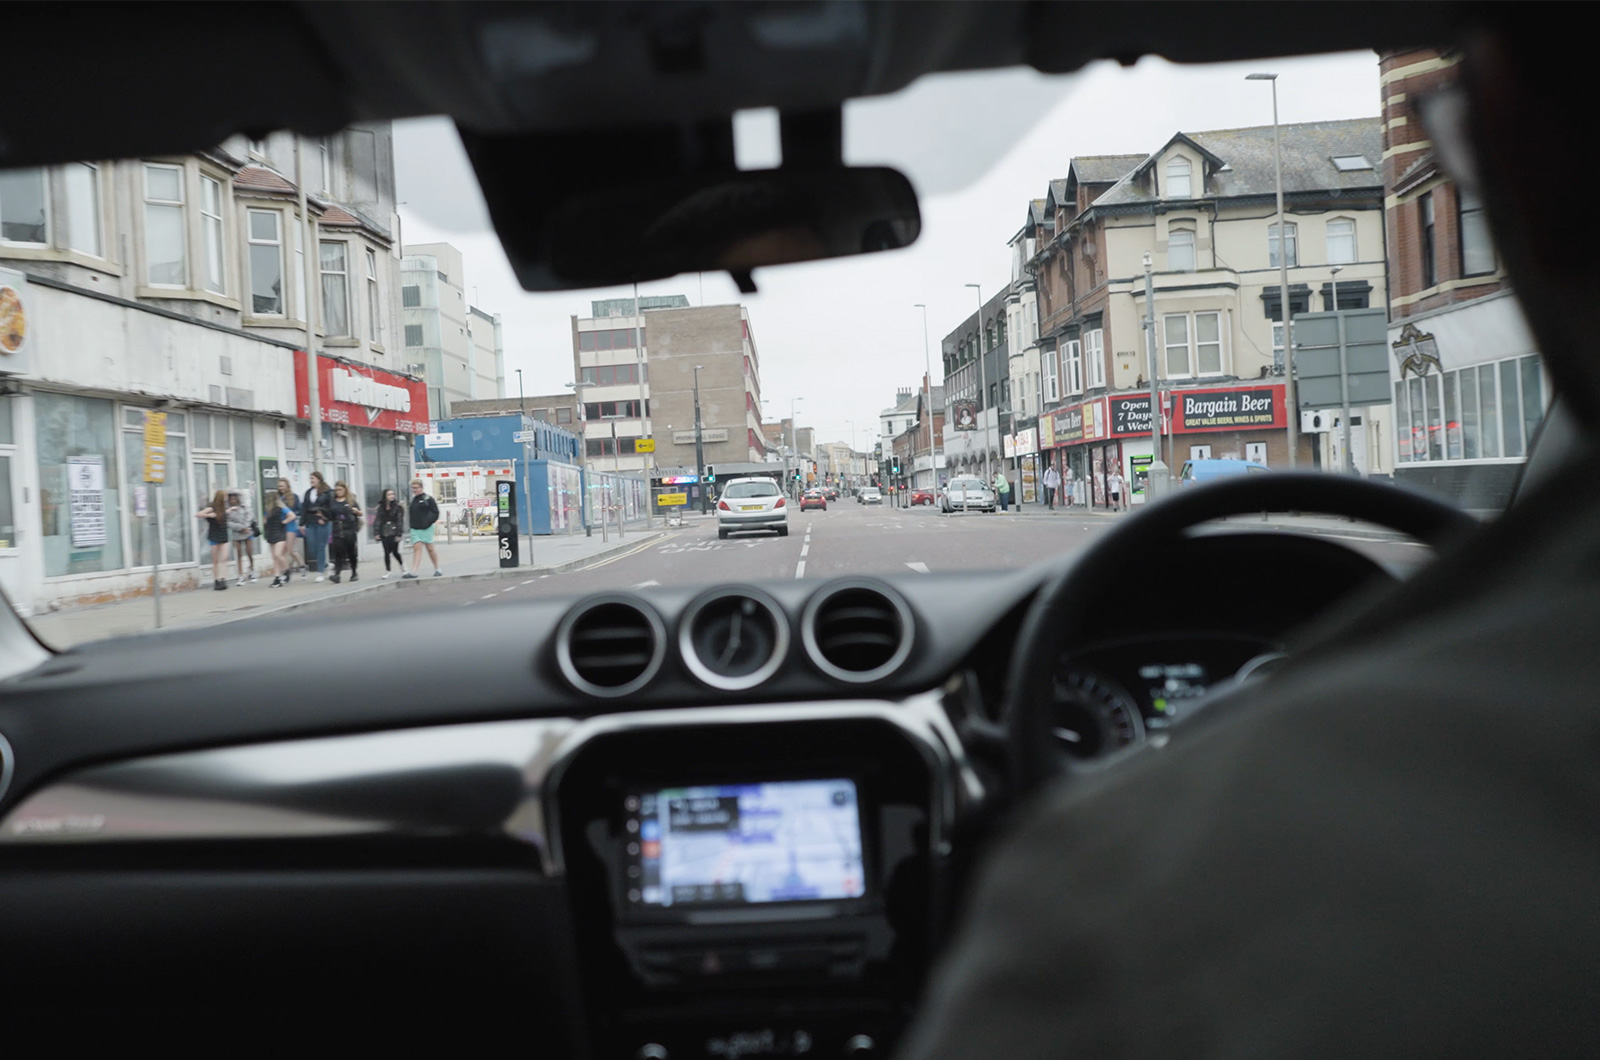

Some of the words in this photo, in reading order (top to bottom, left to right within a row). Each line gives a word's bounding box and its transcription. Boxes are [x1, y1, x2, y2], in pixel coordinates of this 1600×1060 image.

[1121, 401, 1149, 411] Open
[1185, 397, 1238, 418] Bargain
[1241, 395, 1272, 411] Beer
[1118, 412, 1125, 421] 7
[1185, 418, 1201, 426] GREAT
[1202, 417, 1217, 425] VALUE
[1234, 416, 1249, 424] WINES
[1254, 414, 1272, 423] SPIRITS
